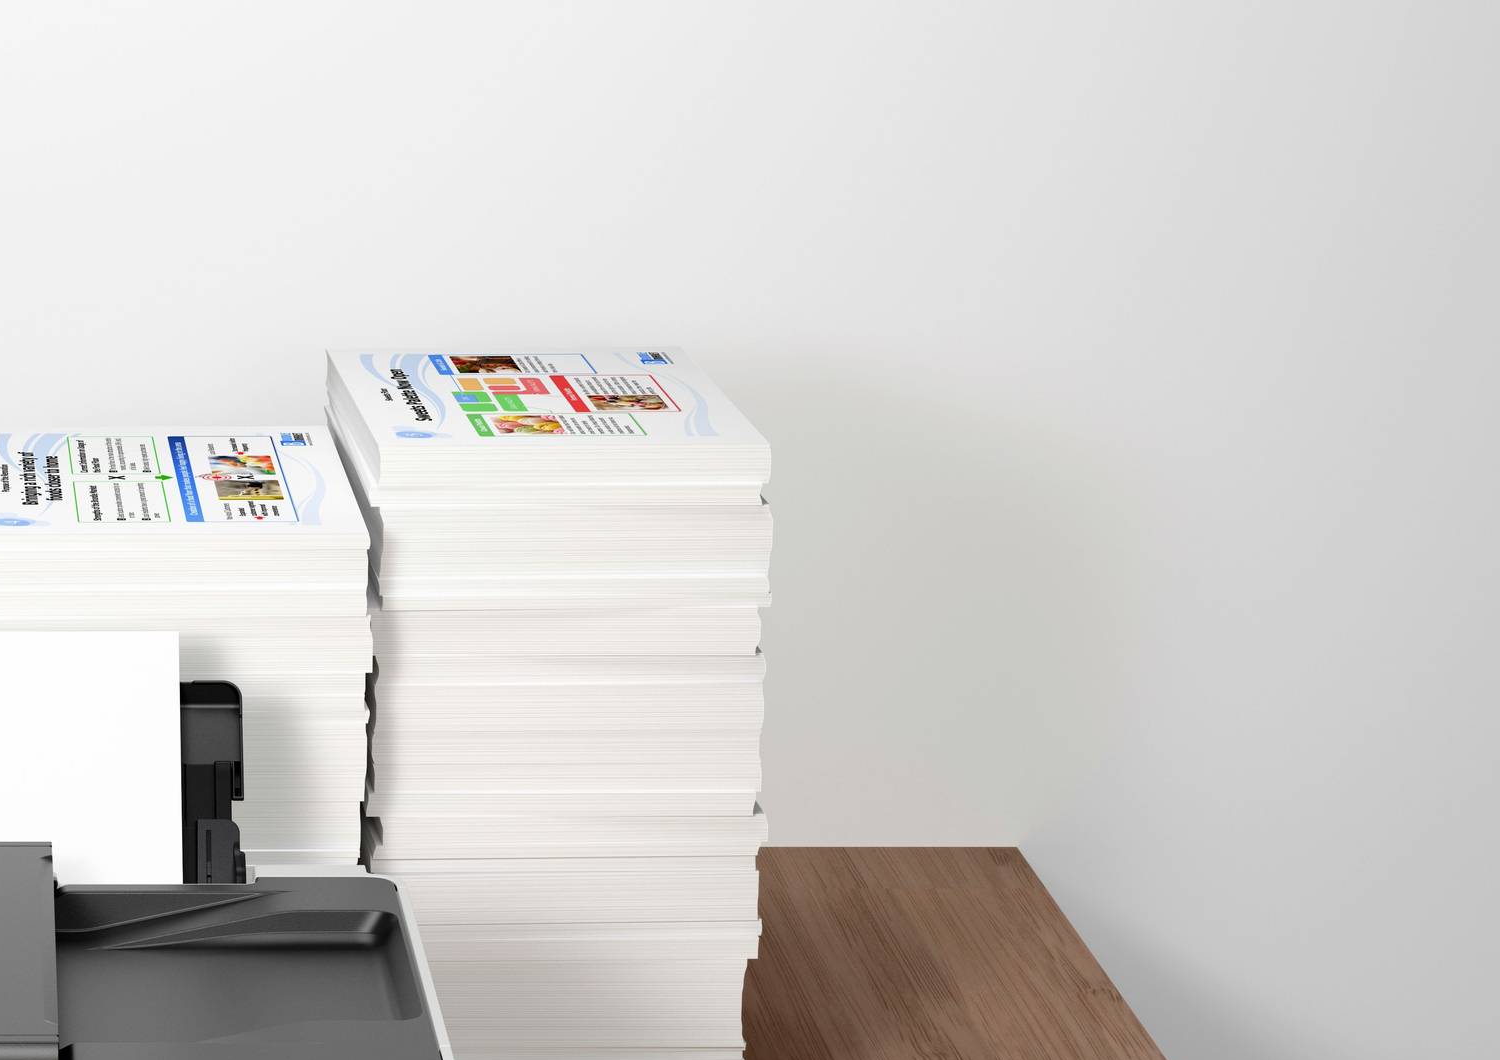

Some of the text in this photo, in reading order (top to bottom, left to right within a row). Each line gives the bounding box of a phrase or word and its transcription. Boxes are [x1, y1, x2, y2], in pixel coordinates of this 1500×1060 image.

[389, 368, 433, 422] Sweets Palette Now Open
[18, 456, 38, 473] variety
[42, 455, 59, 469] home
[19, 472, 37, 482] rich
[44, 473, 62, 488] closer
[20, 485, 42, 506] Bringing
[45, 487, 63, 501] foods
